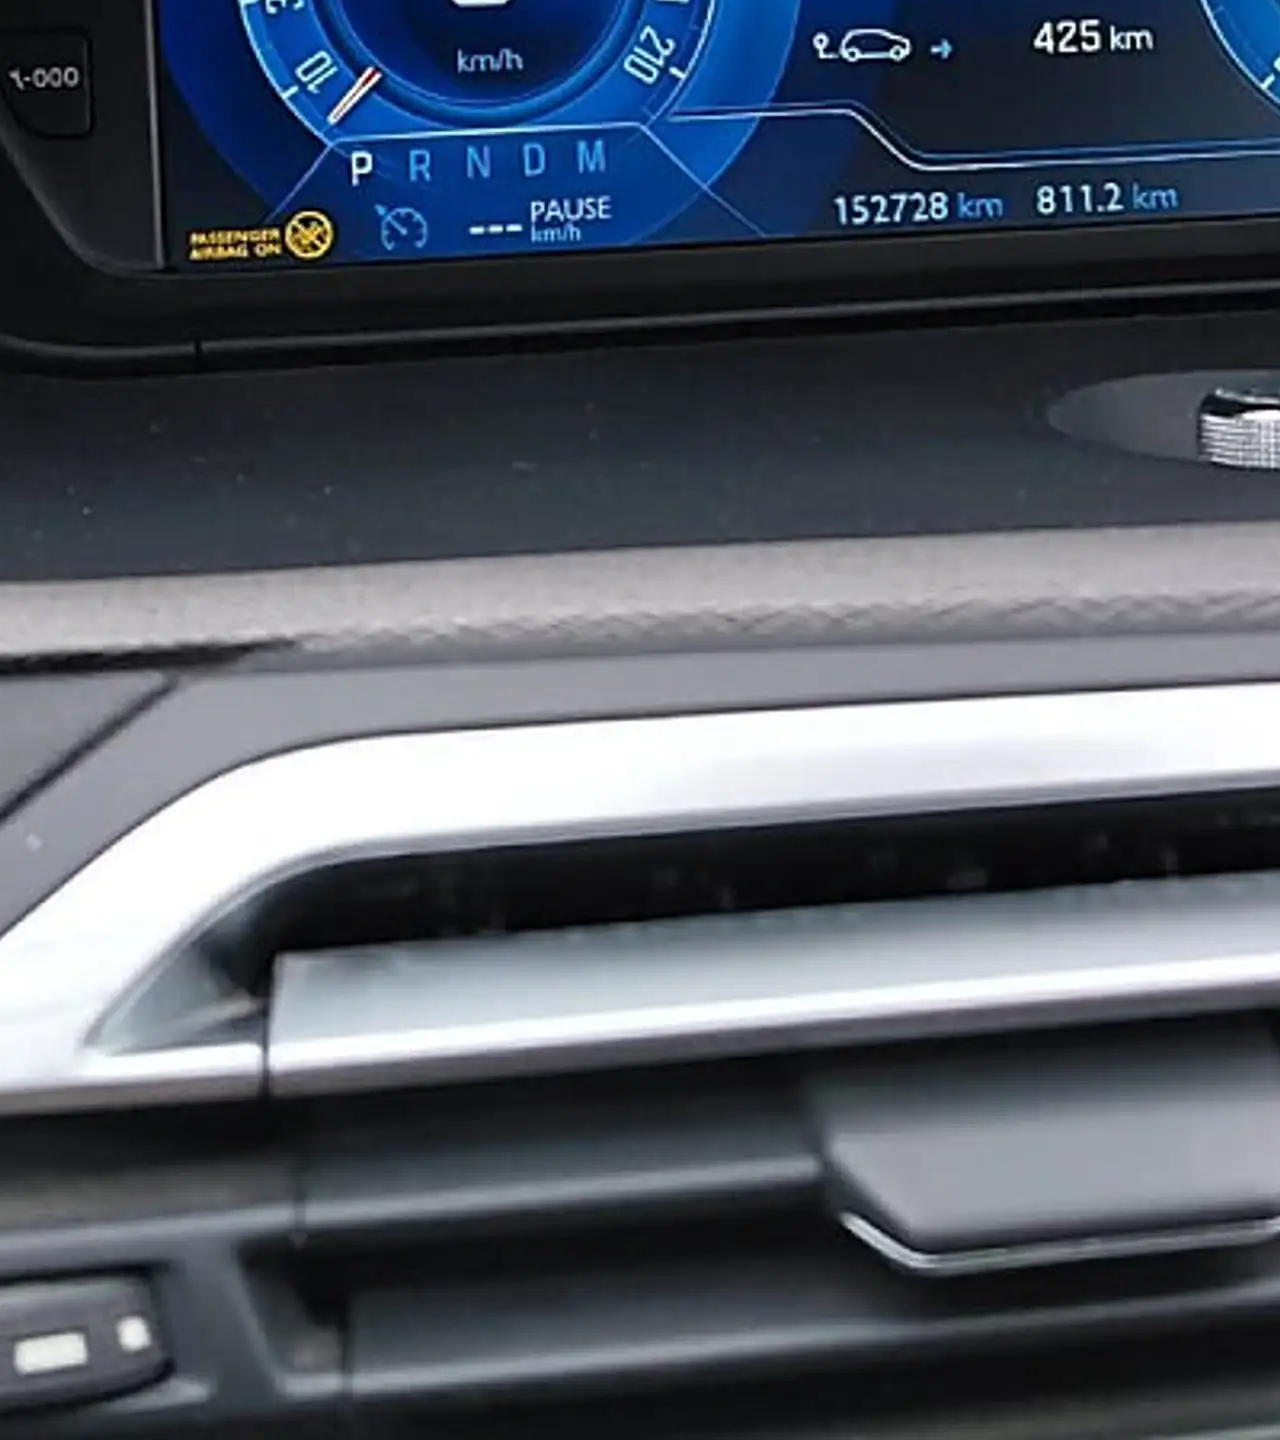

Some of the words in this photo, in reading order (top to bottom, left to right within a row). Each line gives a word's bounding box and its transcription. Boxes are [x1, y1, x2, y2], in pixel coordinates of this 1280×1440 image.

[1033, 19, 1102, 55] 425
[1109, 24, 1154, 52] km
[457, 48, 524, 74] km/h
[624, 25, 676, 84] 210
[294, 50, 339, 94] 10
[351, 150, 373, 187] P
[409, 148, 431, 182] R
[466, 144, 491, 178] N
[523, 141, 546, 178] D
[577, 137, 606, 174] M
[530, 195, 612, 222] PAUSE
[834, 191, 950, 225] 152728
[957, 191, 1003, 219] km
[1036, 182, 1124, 216] 811.2
[1132, 182, 1178, 210] km
[531, 222, 581, 243] km/h
